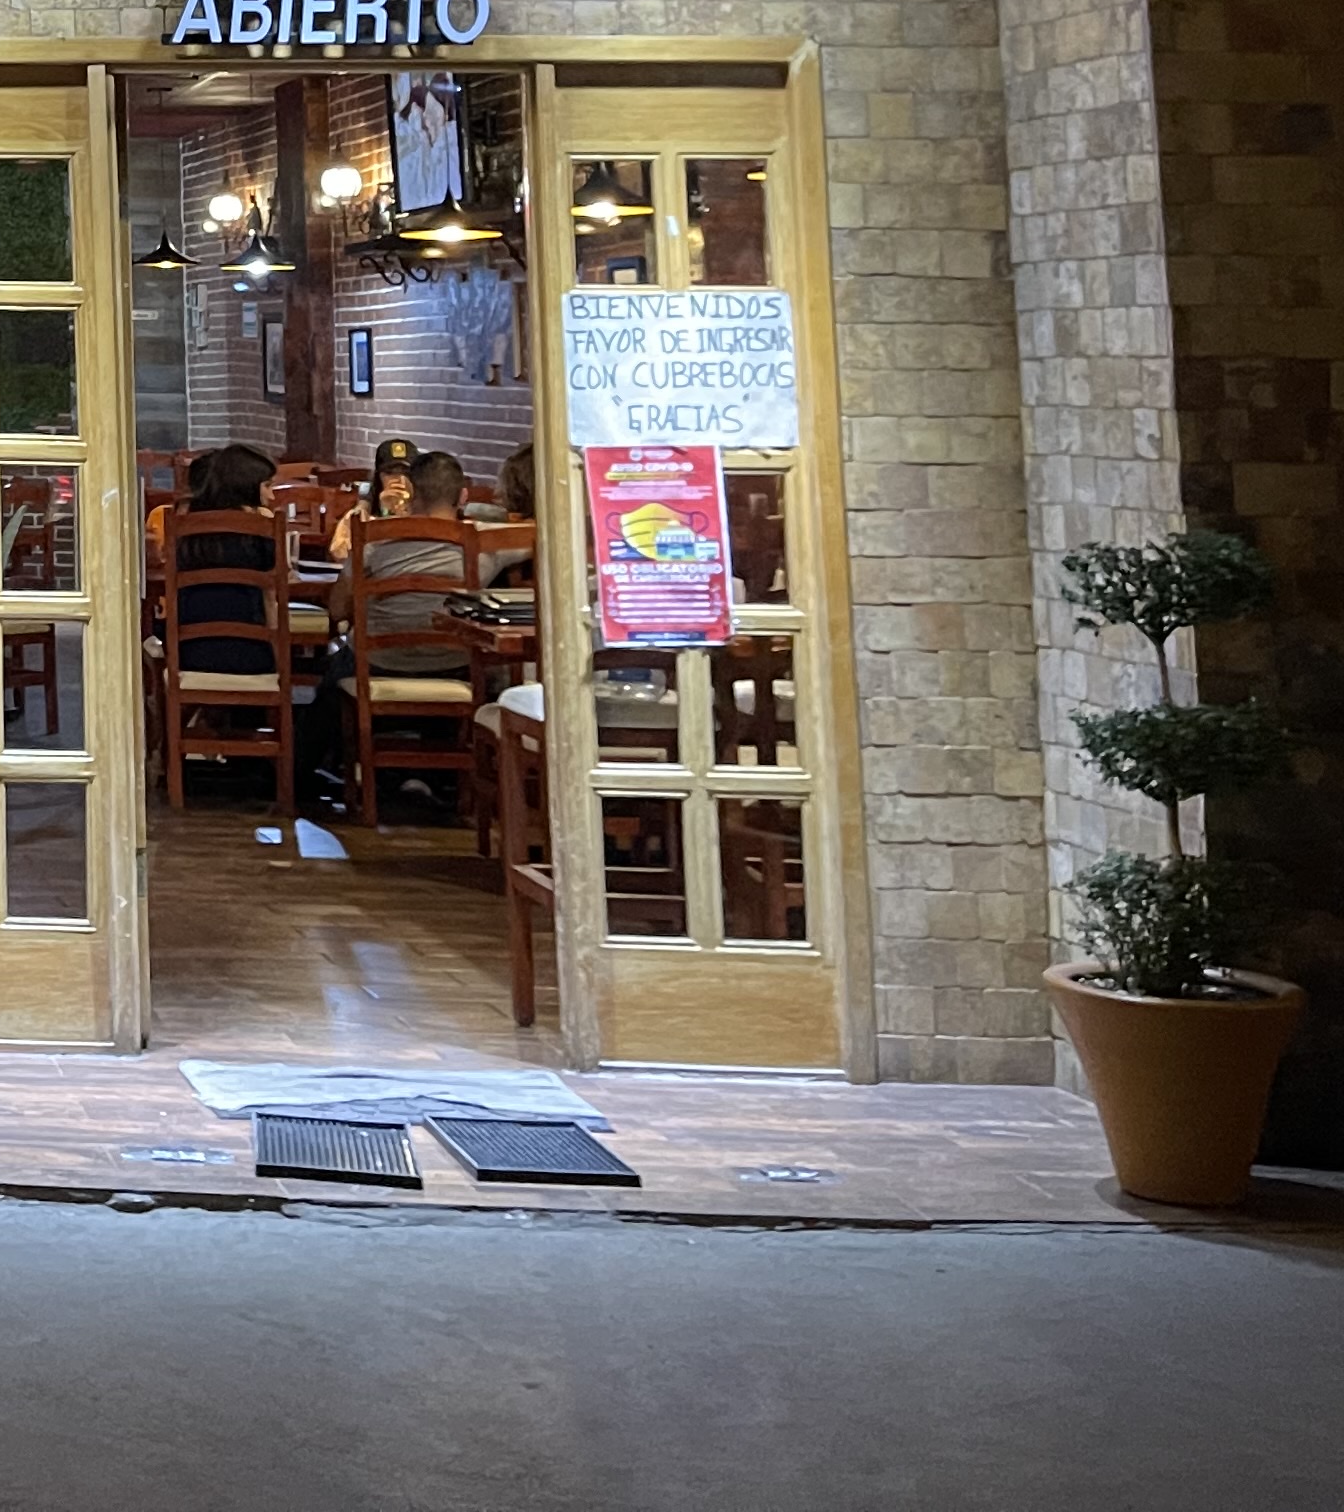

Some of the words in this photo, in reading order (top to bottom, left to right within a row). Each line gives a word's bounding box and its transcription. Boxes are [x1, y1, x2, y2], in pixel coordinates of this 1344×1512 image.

[566, 328, 647, 354] FAVOR
[661, 329, 692, 354] DE
[697, 328, 793, 355] INGRESAR
[569, 362, 619, 390] CON
[632, 361, 795, 389] CUBREBOCAS
